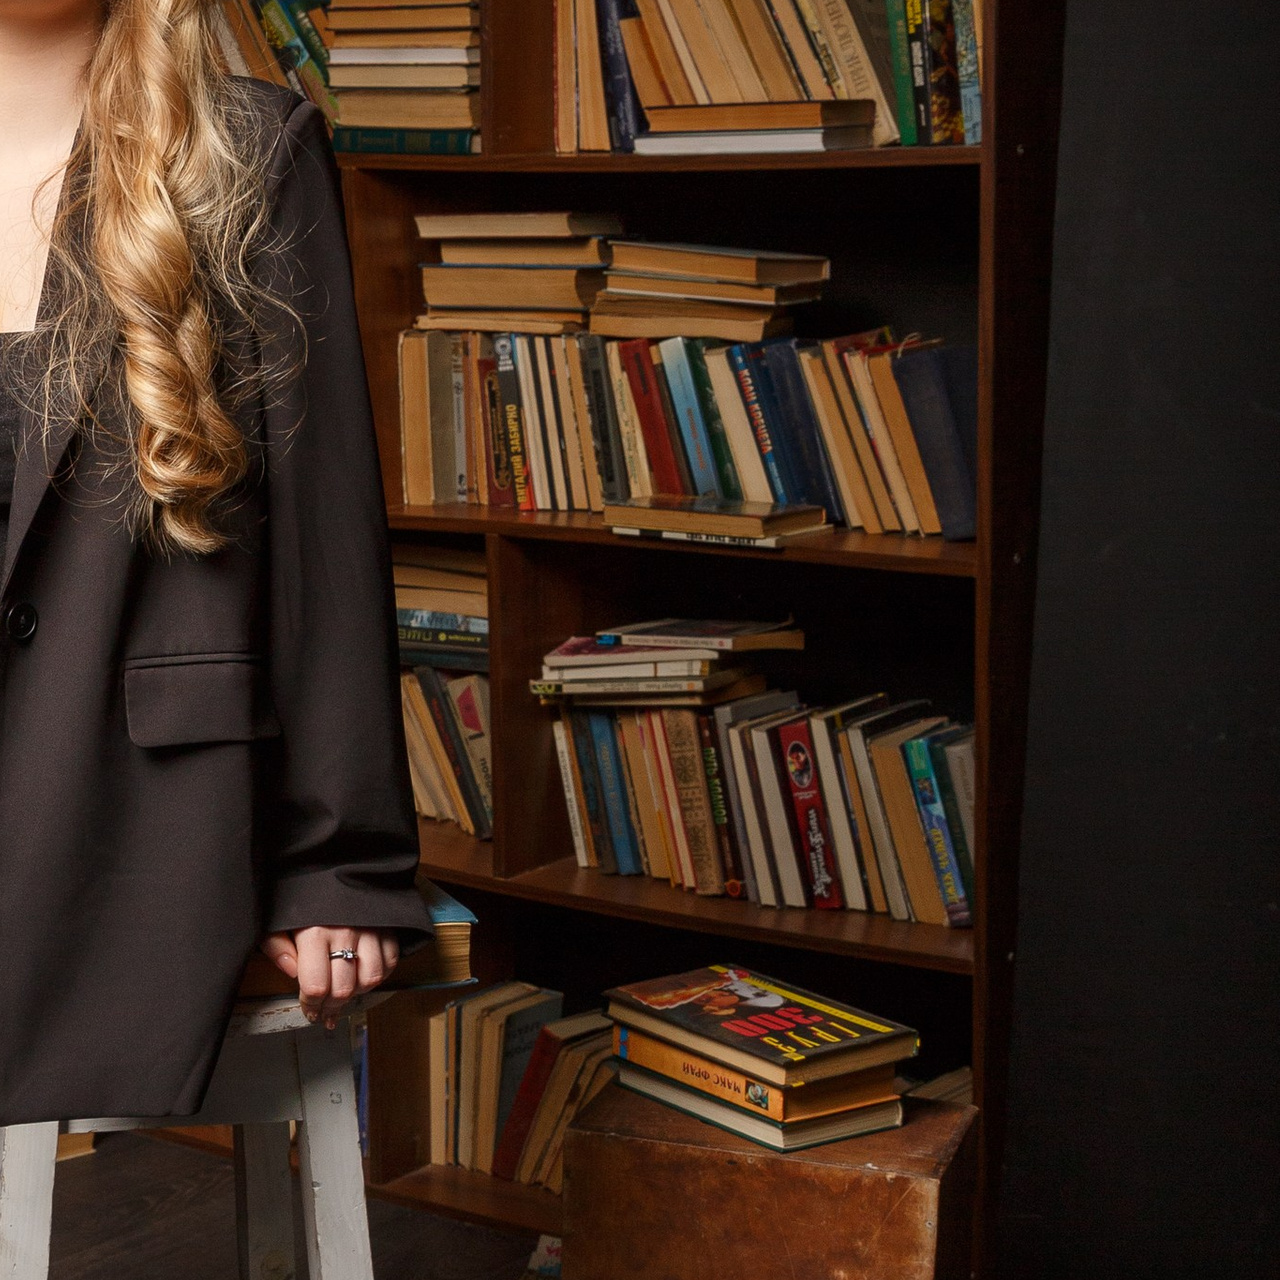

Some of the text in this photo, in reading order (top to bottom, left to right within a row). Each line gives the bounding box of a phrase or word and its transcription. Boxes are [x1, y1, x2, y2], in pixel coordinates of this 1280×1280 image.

[738, 367, 774, 454] КЛАН КРЕЧЕТА
[507, 403, 527, 504] ВИТАЛИЙ ЗАБИРКО
[704, 746, 729, 826] ПУТЬ КЛАНОВ
[720, 1006, 824, 1038] 300
[761, 1021, 860, 1053] ГРУЗ
[682, 1061, 741, 1094] МАКС ФРАЙ
